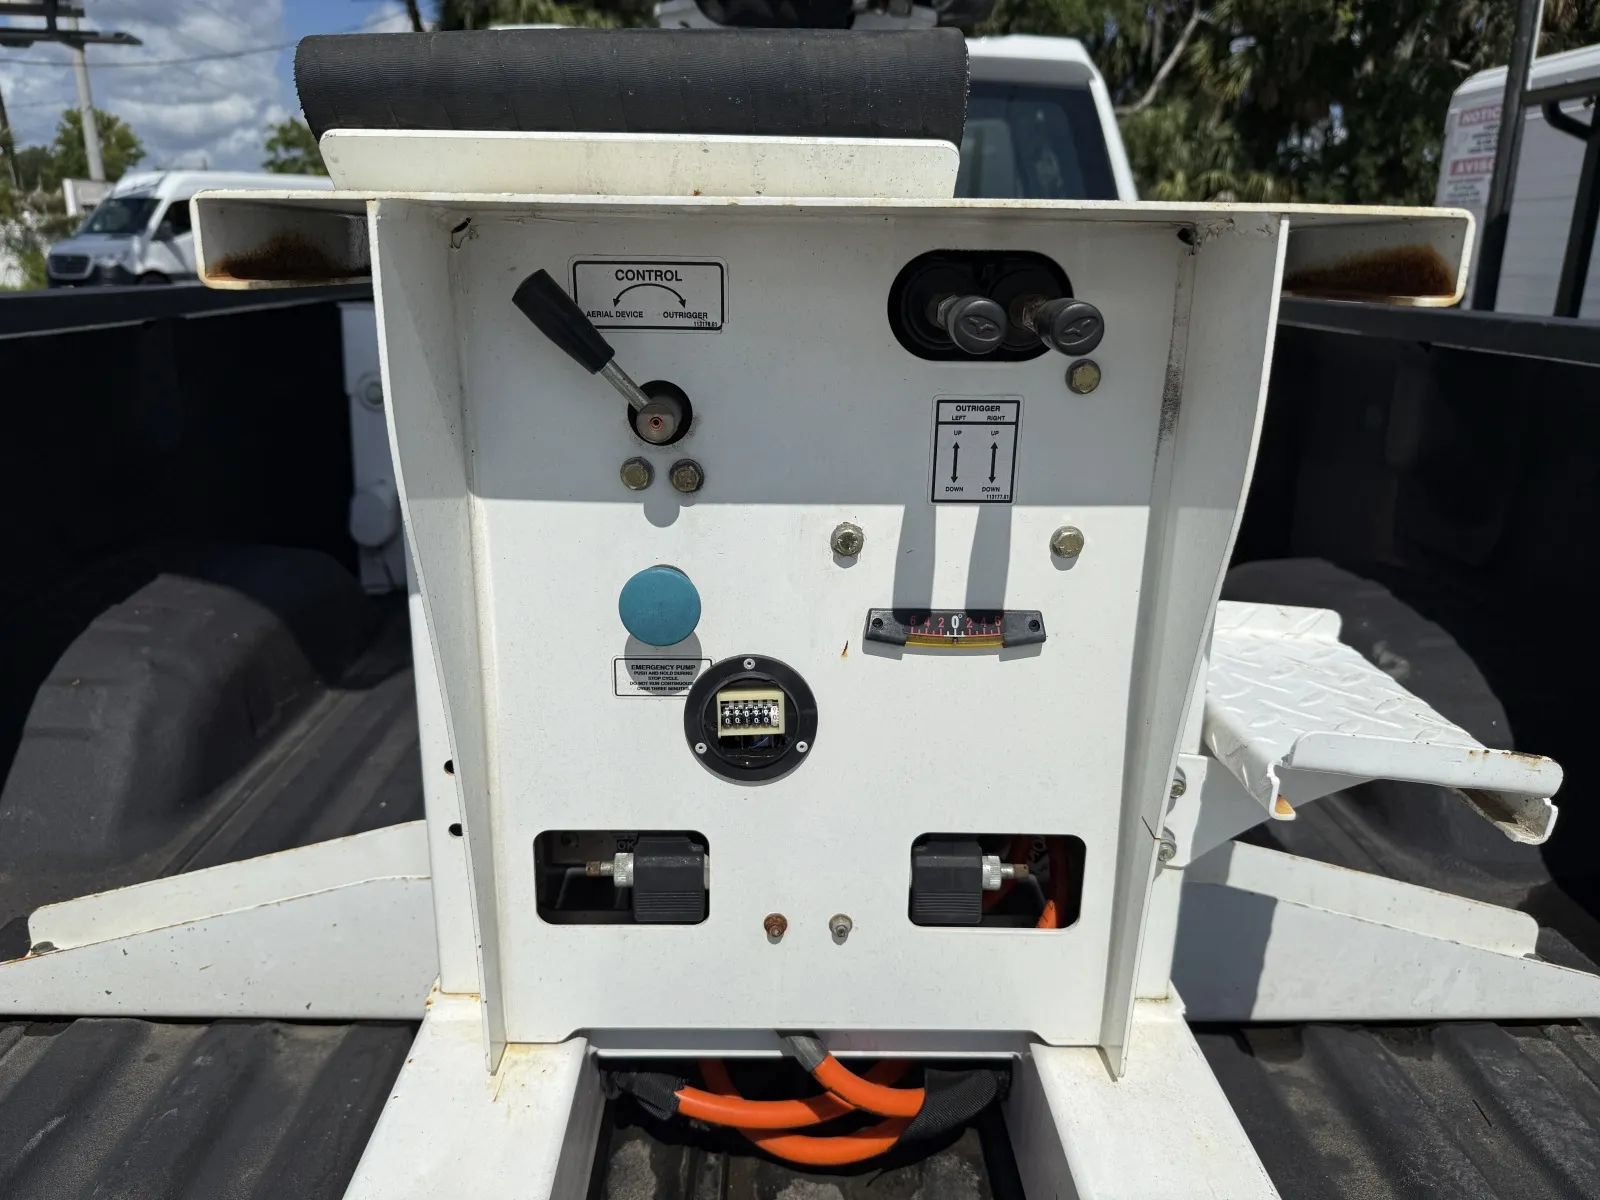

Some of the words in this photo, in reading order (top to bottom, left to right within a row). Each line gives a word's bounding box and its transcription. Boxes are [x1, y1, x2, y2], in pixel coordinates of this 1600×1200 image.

[1461, 107, 1503, 125] NOTIC
[614, 269, 683, 282] CONTROL
[586, 310, 614, 318] AERIAL
[615, 310, 644, 318] DEVICE
[662, 311, 708, 319] OUTRIGGER
[923, 616, 931, 628] 4
[938, 616, 945, 628] 2
[966, 617, 973, 628] 2
